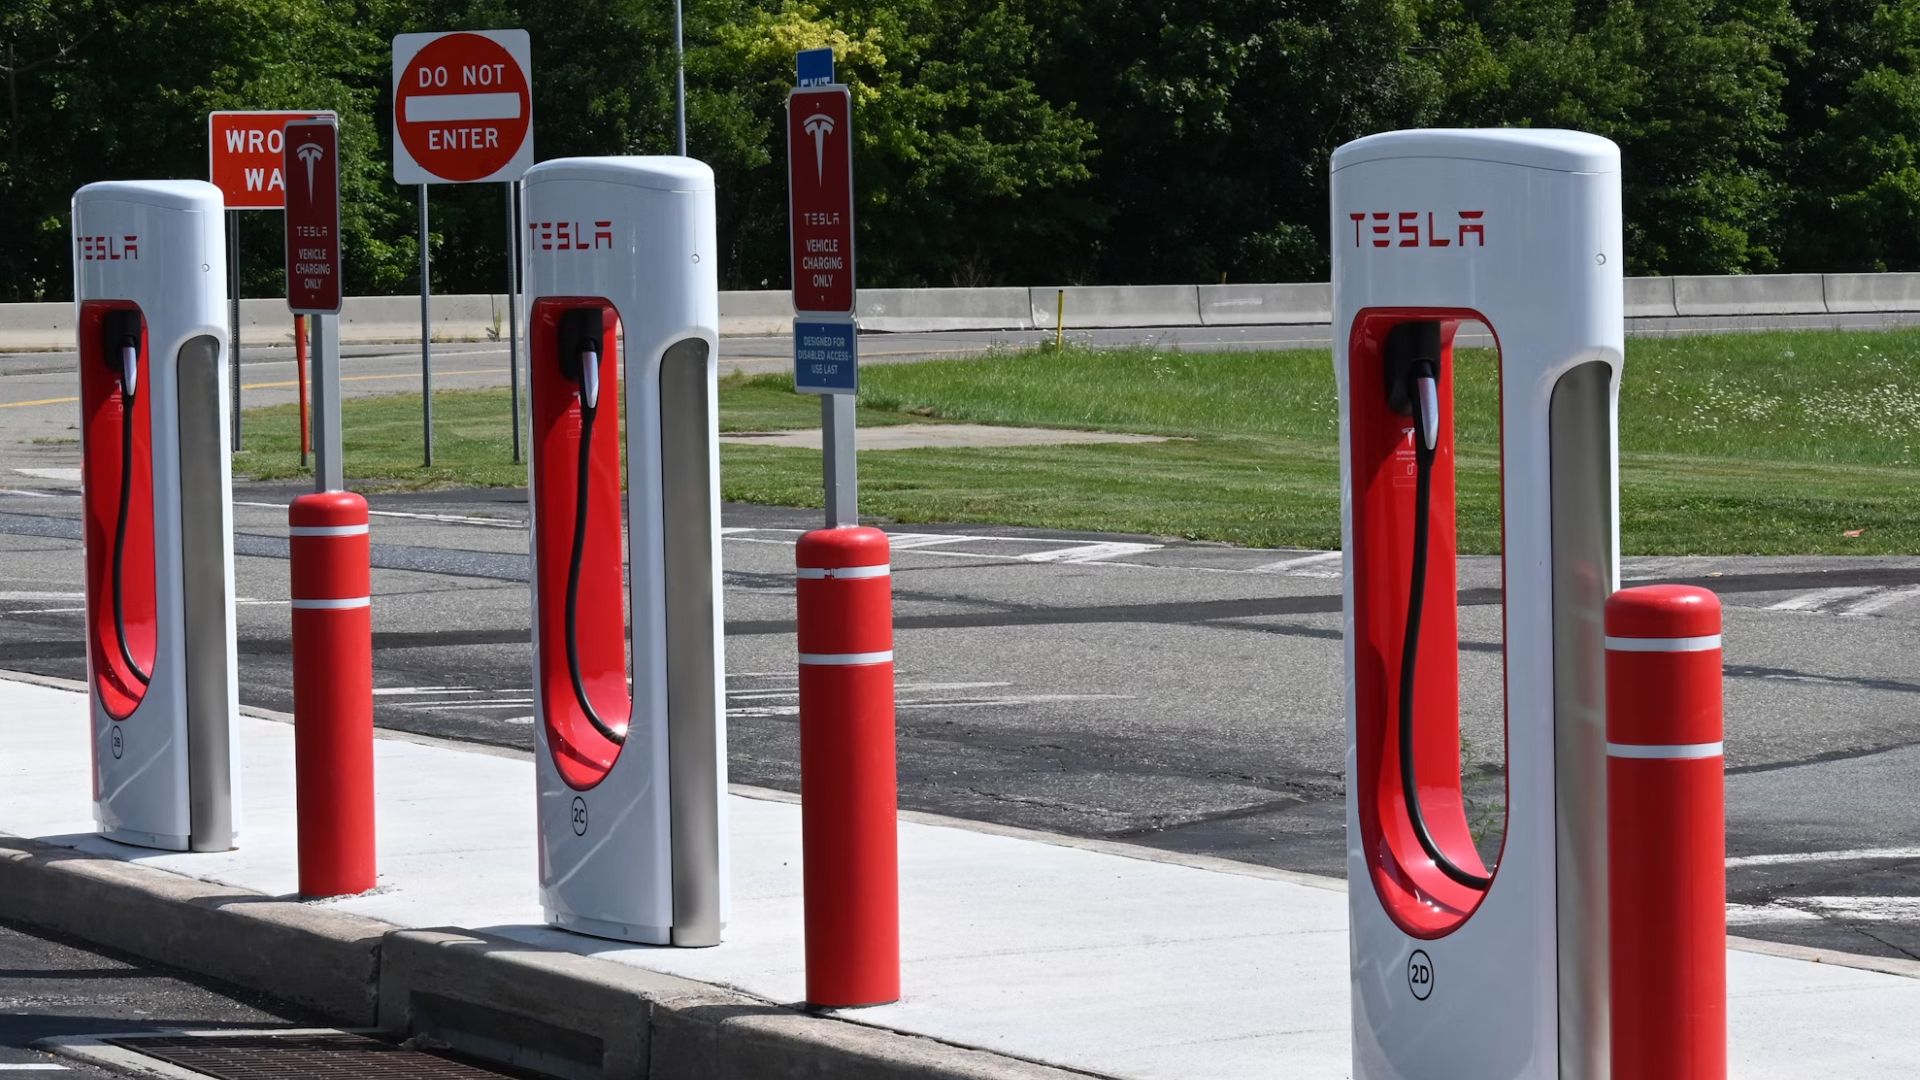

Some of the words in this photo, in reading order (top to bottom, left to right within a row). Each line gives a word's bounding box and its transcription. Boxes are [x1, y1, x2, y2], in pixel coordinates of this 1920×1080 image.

[418, 66, 448, 88] DO
[463, 64, 505, 86] NOT
[225, 129, 284, 154] WRO
[428, 128, 498, 150] ENTER
[244, 167, 285, 192] WA
[804, 212, 840, 226] TESLA
[296, 225, 328, 237] TESLA
[528, 221, 613, 251] TESLA
[1350, 210, 1484, 248] TESLA
[77, 235, 138, 261] TESLA
[806, 239, 838, 253] VEHICLE
[298, 248, 326, 260] VEHICLE
[295, 262, 331, 275] CHARGING
[802, 256, 843, 270] CHARGING
[304, 277, 322, 290] ONLY
[812, 274, 834, 288] ONLY
[803, 336, 832, 347] DESIGNED
[833, 336, 846, 347] FOR
[797, 350, 826, 360] DISABLED
[811, 364, 823, 374] USE
[823, 364, 839, 375] LAST
[573, 808, 585, 824] 2C
[1411, 964, 1430, 984] 2D
